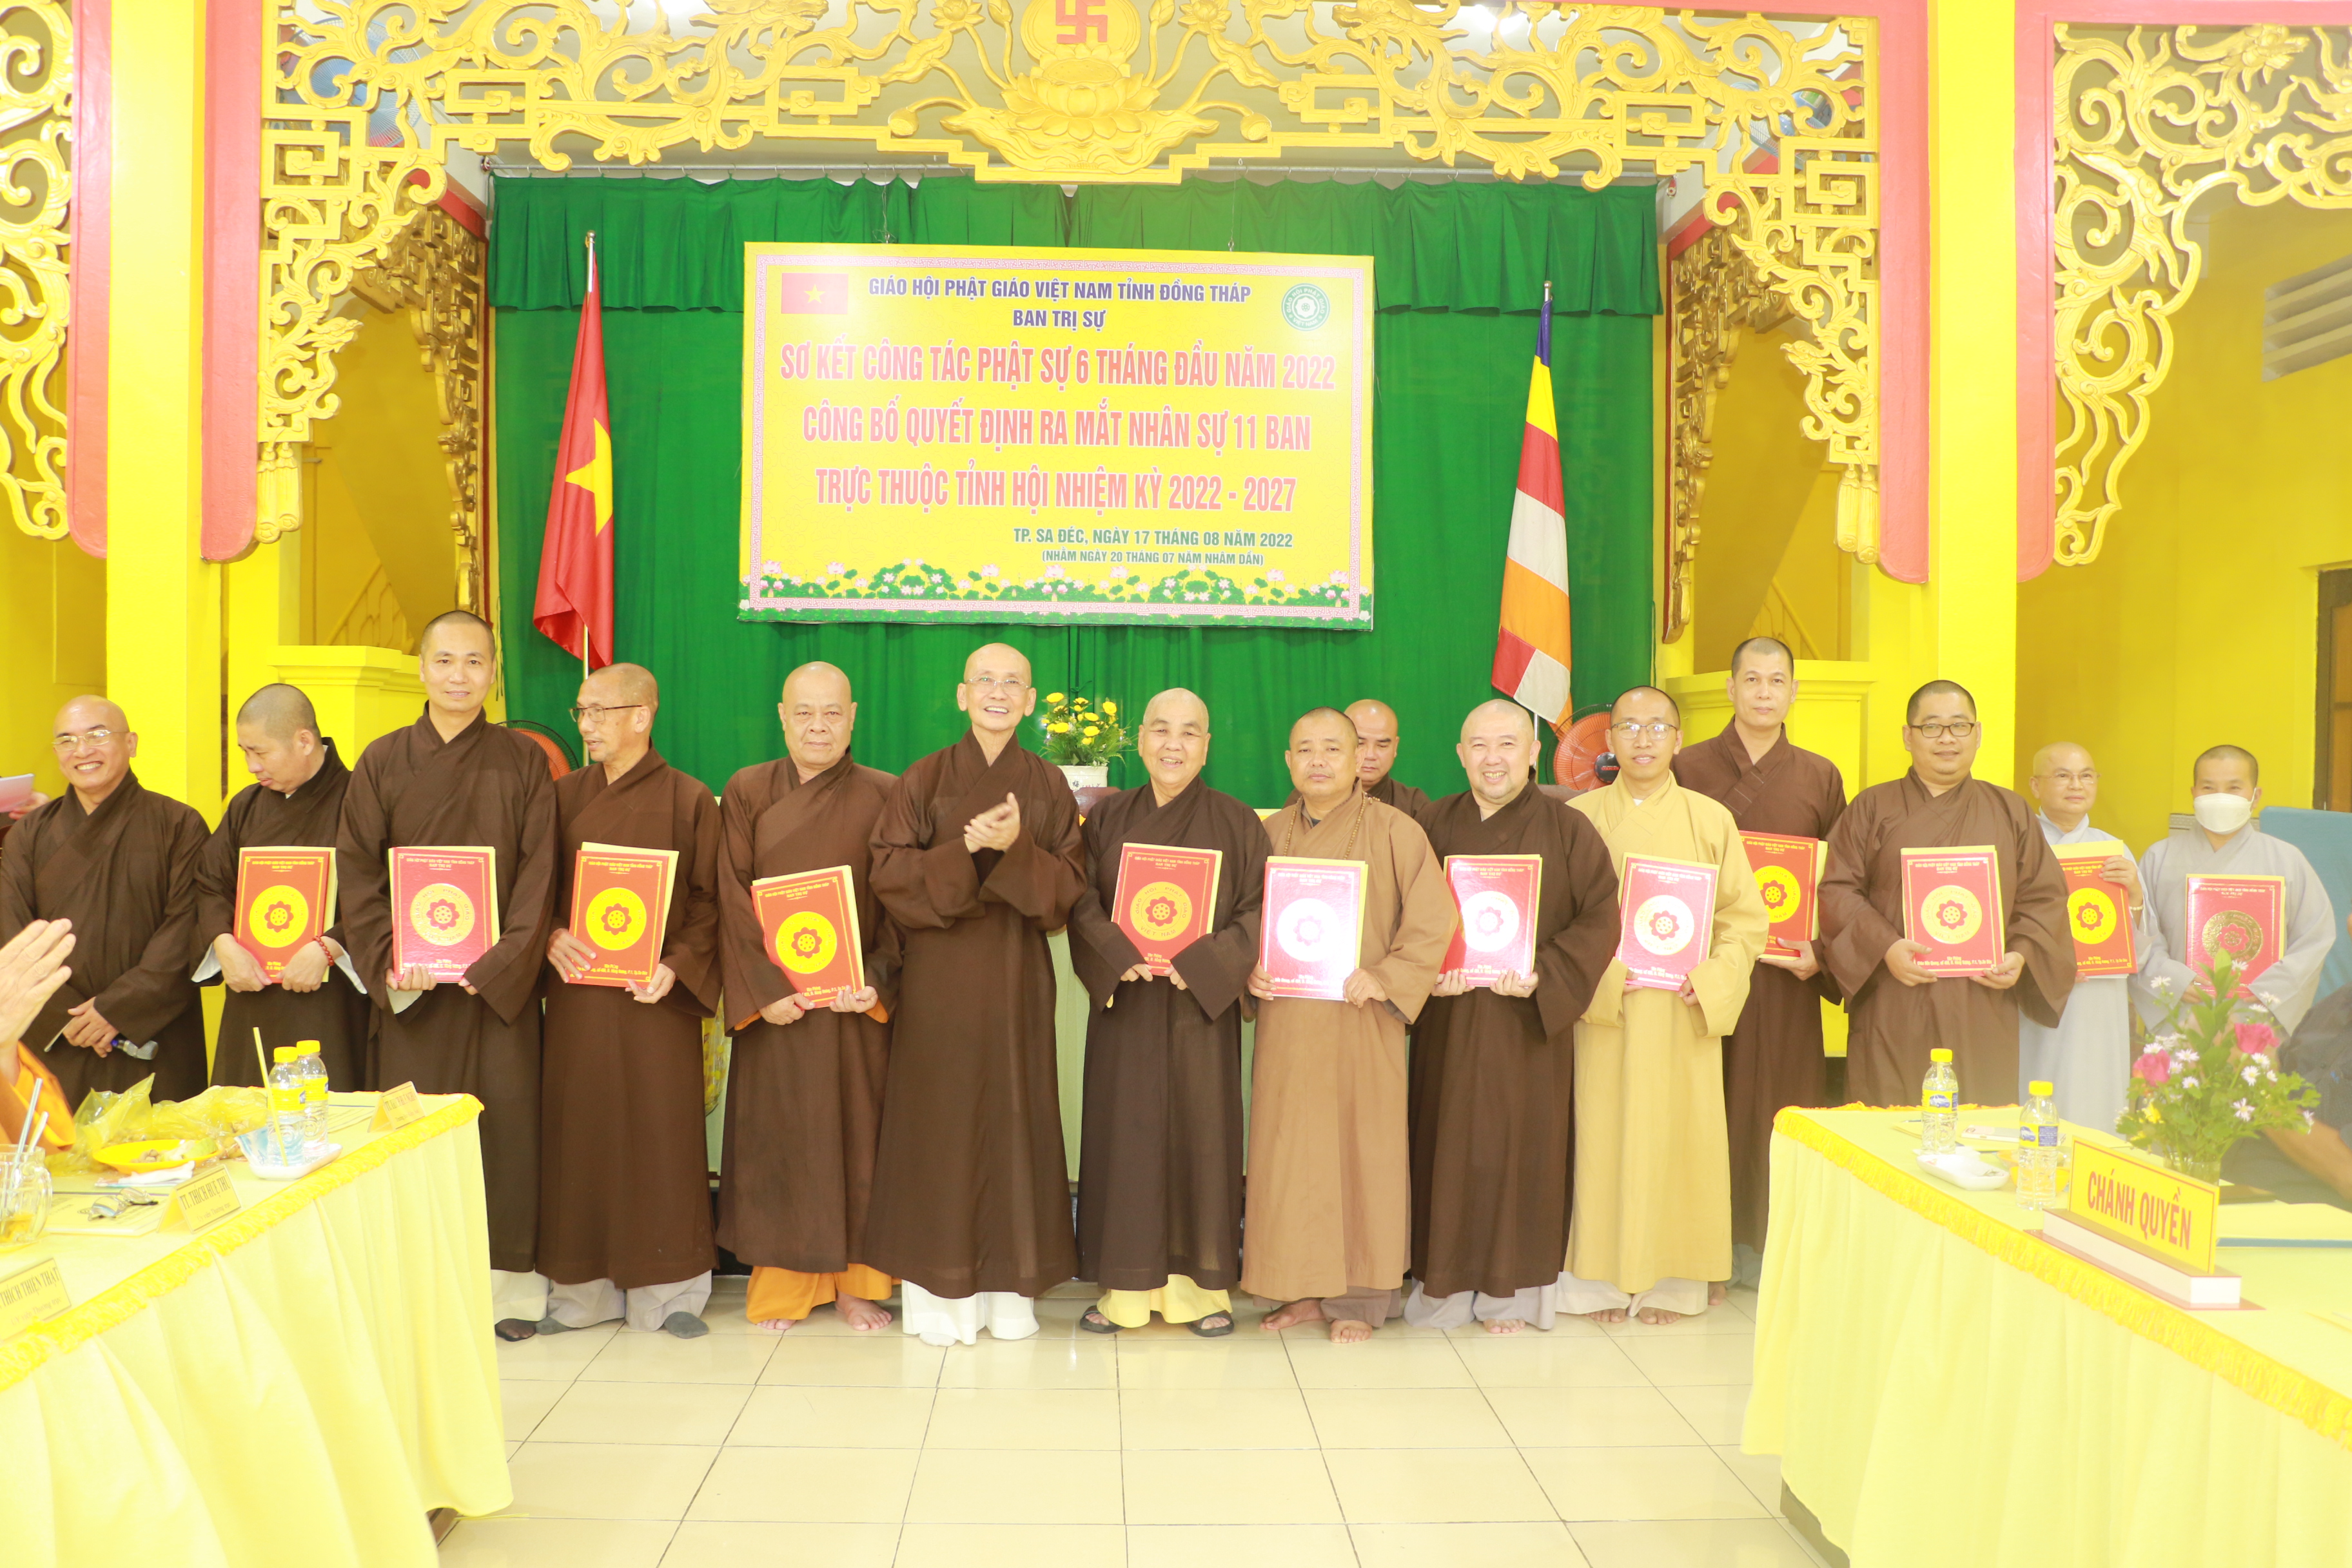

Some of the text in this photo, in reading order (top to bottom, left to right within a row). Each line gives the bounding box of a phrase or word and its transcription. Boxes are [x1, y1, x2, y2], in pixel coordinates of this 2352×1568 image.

[870, 275, 1251, 302] GIÁO HỘI PHẬT GIÁO VIỆT NAM TỈNH ĐỒNG THÁP
[1014, 310, 1106, 331] BAN TRỊ SỰ
[781, 333, 1335, 391] SƠ KẾT CÔNG TÁC PHẬT SỰ 6 THÁNG ĐẦU NĂM 2022
[803, 395, 1311, 456] CÔNG BỐ QUYẾT ĐỊNH RA MẮT NHÂN SỰ 11 BAN
[816, 466, 870, 512] TRỰC
[878, 462, 948, 513] THUỘC
[956, 458, 1005, 506] TỈNH
[1012, 465, 1048, 515] HỘI
[1055, 466, 1127, 516] NHIỆM
[1135, 467, 1162, 509] KỲ
[1169, 475, 1222, 510] 2022
[1243, 476, 1296, 512] 2027
[1014, 526, 1293, 547] TP. SA ĐÉC, NGÀY 17 THÁNG 08 NĂM 2022
[1043, 547, 1076, 562] (NHẰM
[1080, 549, 1107, 562] NGÀY
[1110, 551, 1122, 562] 20
[1126, 550, 1159, 563] THÁNG
[1162, 553, 1175, 563] 07
[1178, 551, 1201, 564] NĂM
[1205, 551, 1235, 564] NHÂM
[180, 1194, 192, 1210] TT.
[188, 1184, 209, 1206] THÍCH
[2088, 1168, 2191, 1250] CHÁNH QUYỀN
